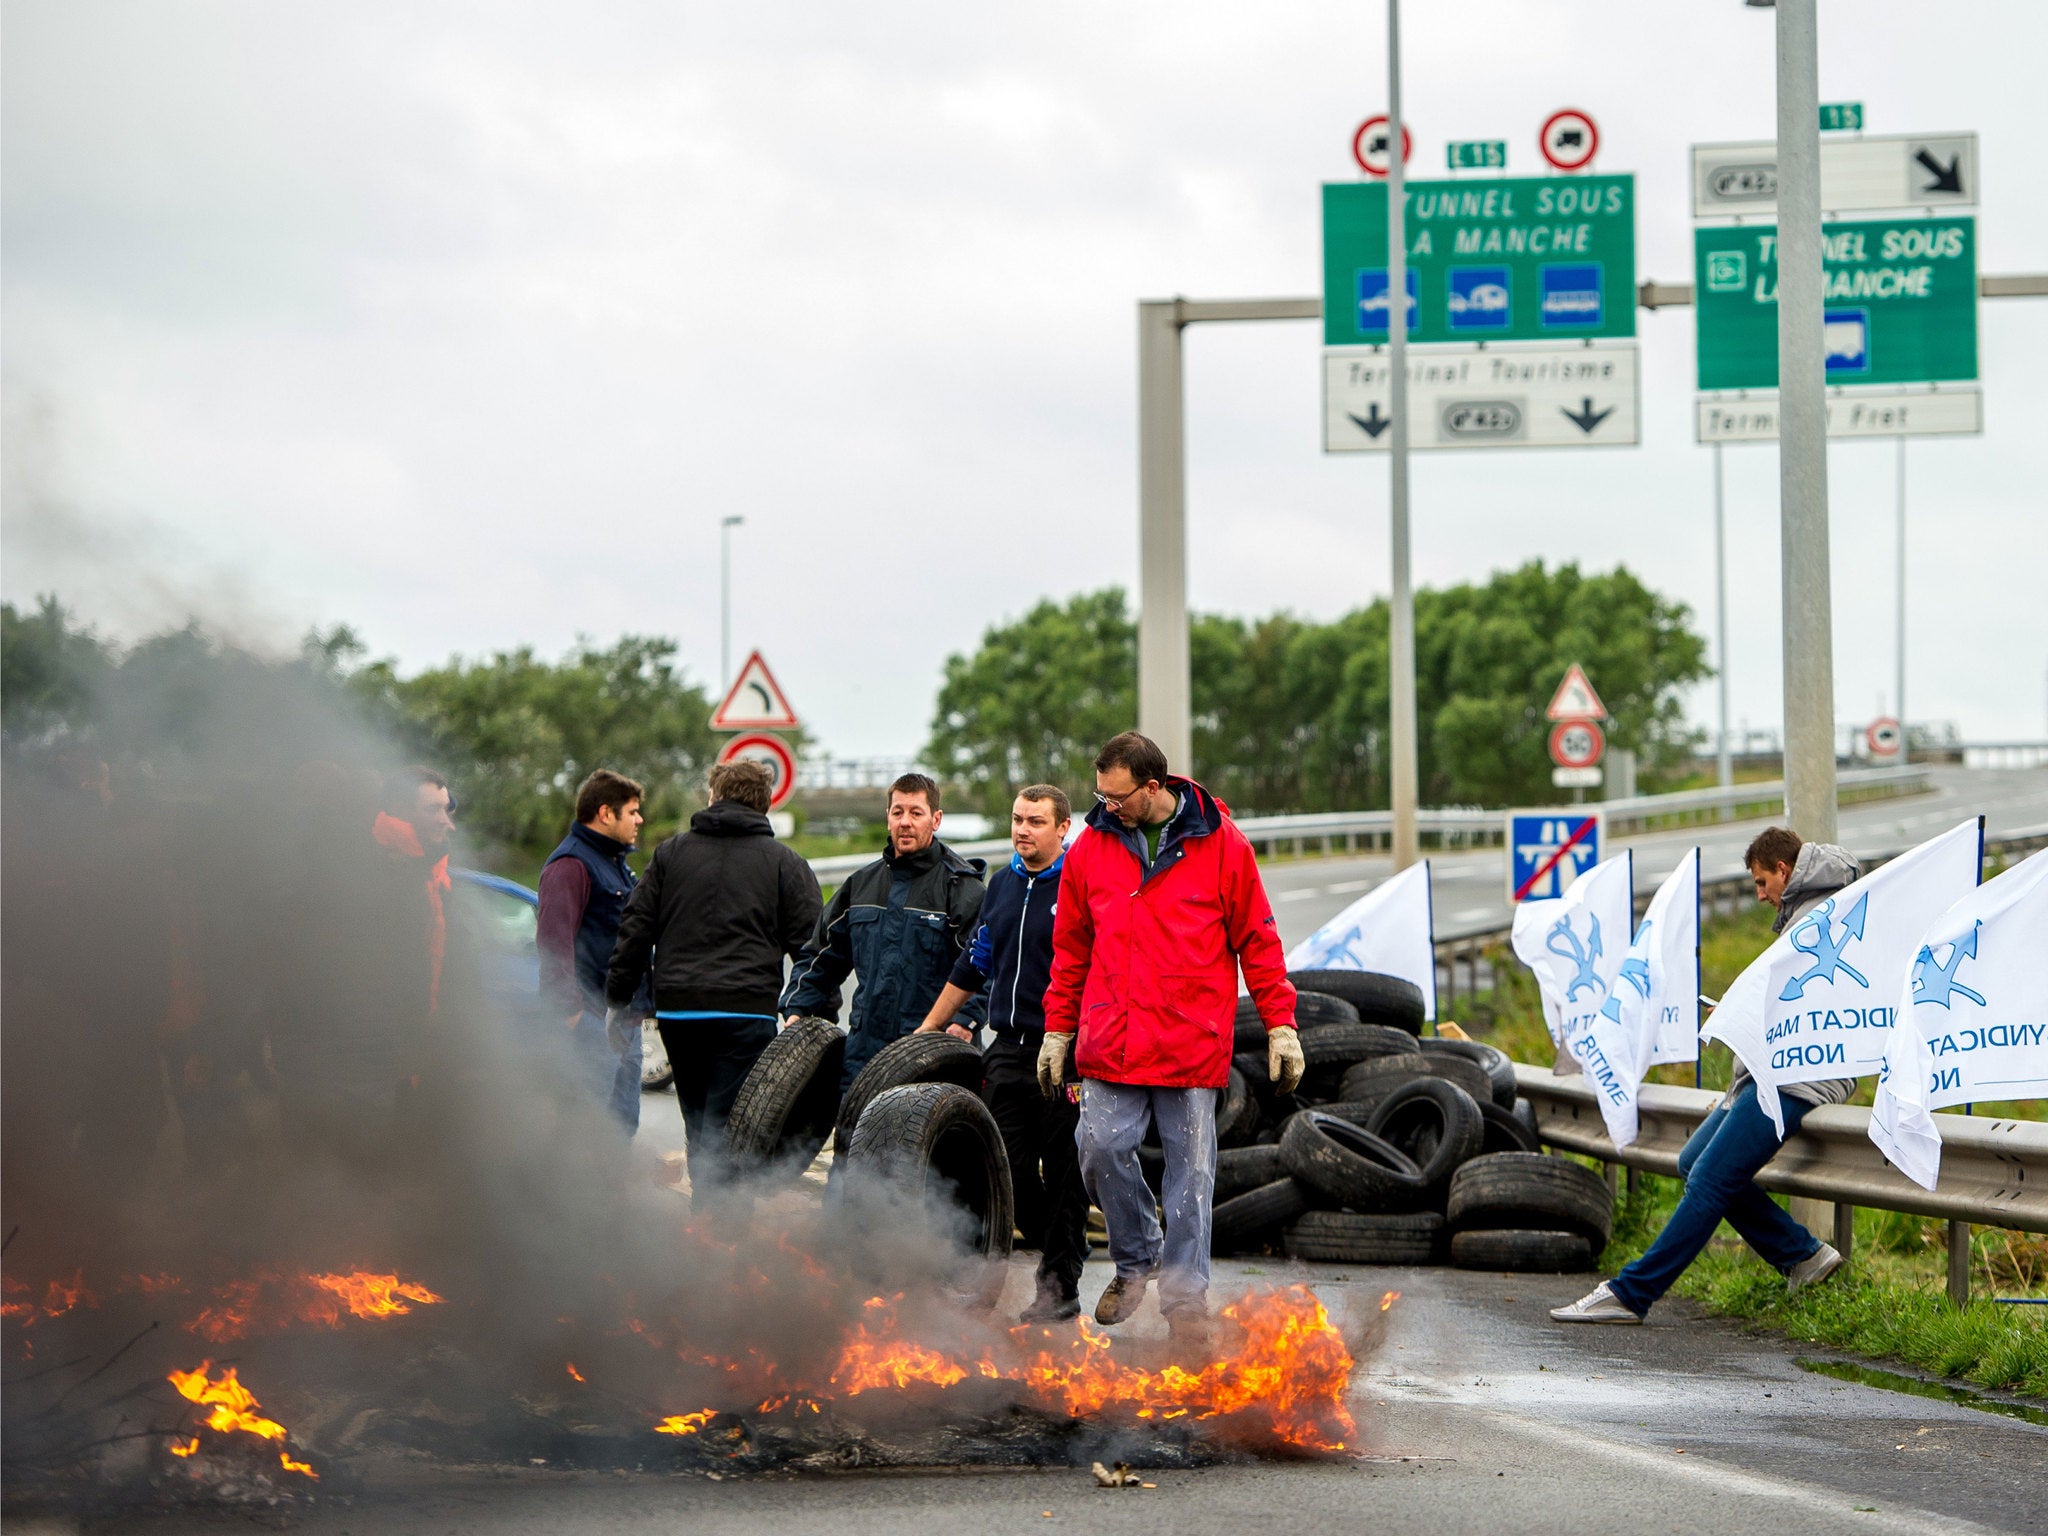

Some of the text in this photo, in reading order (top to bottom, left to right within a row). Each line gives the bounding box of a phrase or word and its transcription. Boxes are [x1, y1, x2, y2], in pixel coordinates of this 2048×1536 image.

[1473, 142, 1501, 167] 15
[1536, 186, 1623, 215] SOUS
[1454, 223, 1591, 254] MANCHE
[1757, 227, 1964, 264] TNEL SOUS
[1491, 357, 1616, 384] Tourisme
[1851, 403, 1906, 429] Fret
